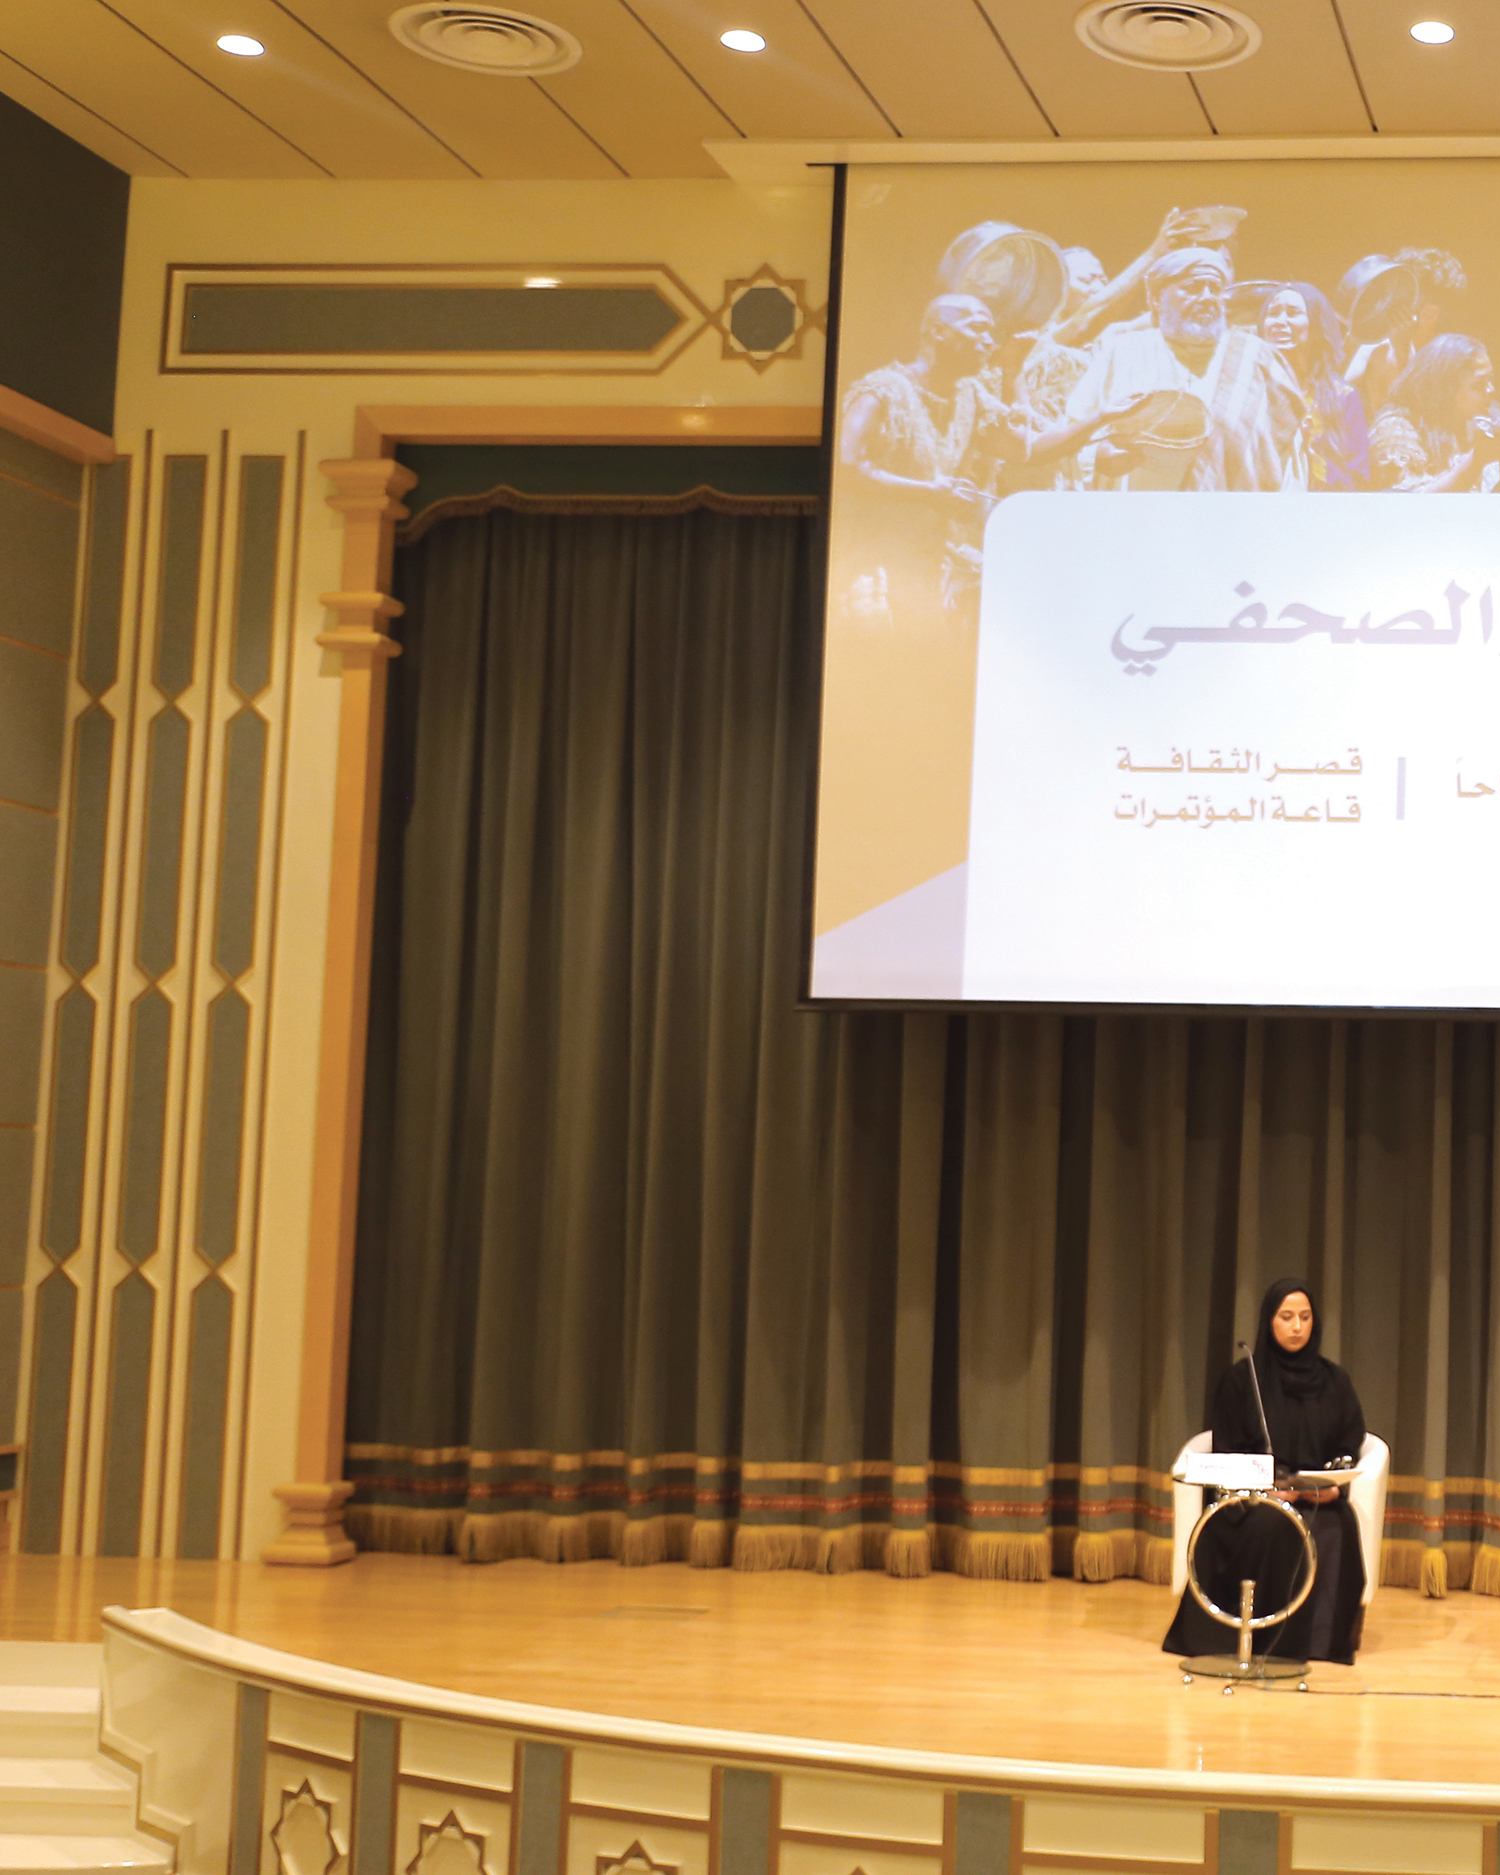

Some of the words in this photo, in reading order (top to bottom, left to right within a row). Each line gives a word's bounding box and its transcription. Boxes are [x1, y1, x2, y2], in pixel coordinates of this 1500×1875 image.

[1109, 580, 1493, 677] الصحفي
[1116, 747, 1260, 773] الثقافة
[1263, 747, 1363, 782] قصر
[1114, 794, 1265, 829] المؤتمرات
[1271, 795, 1362, 823] قاعة
